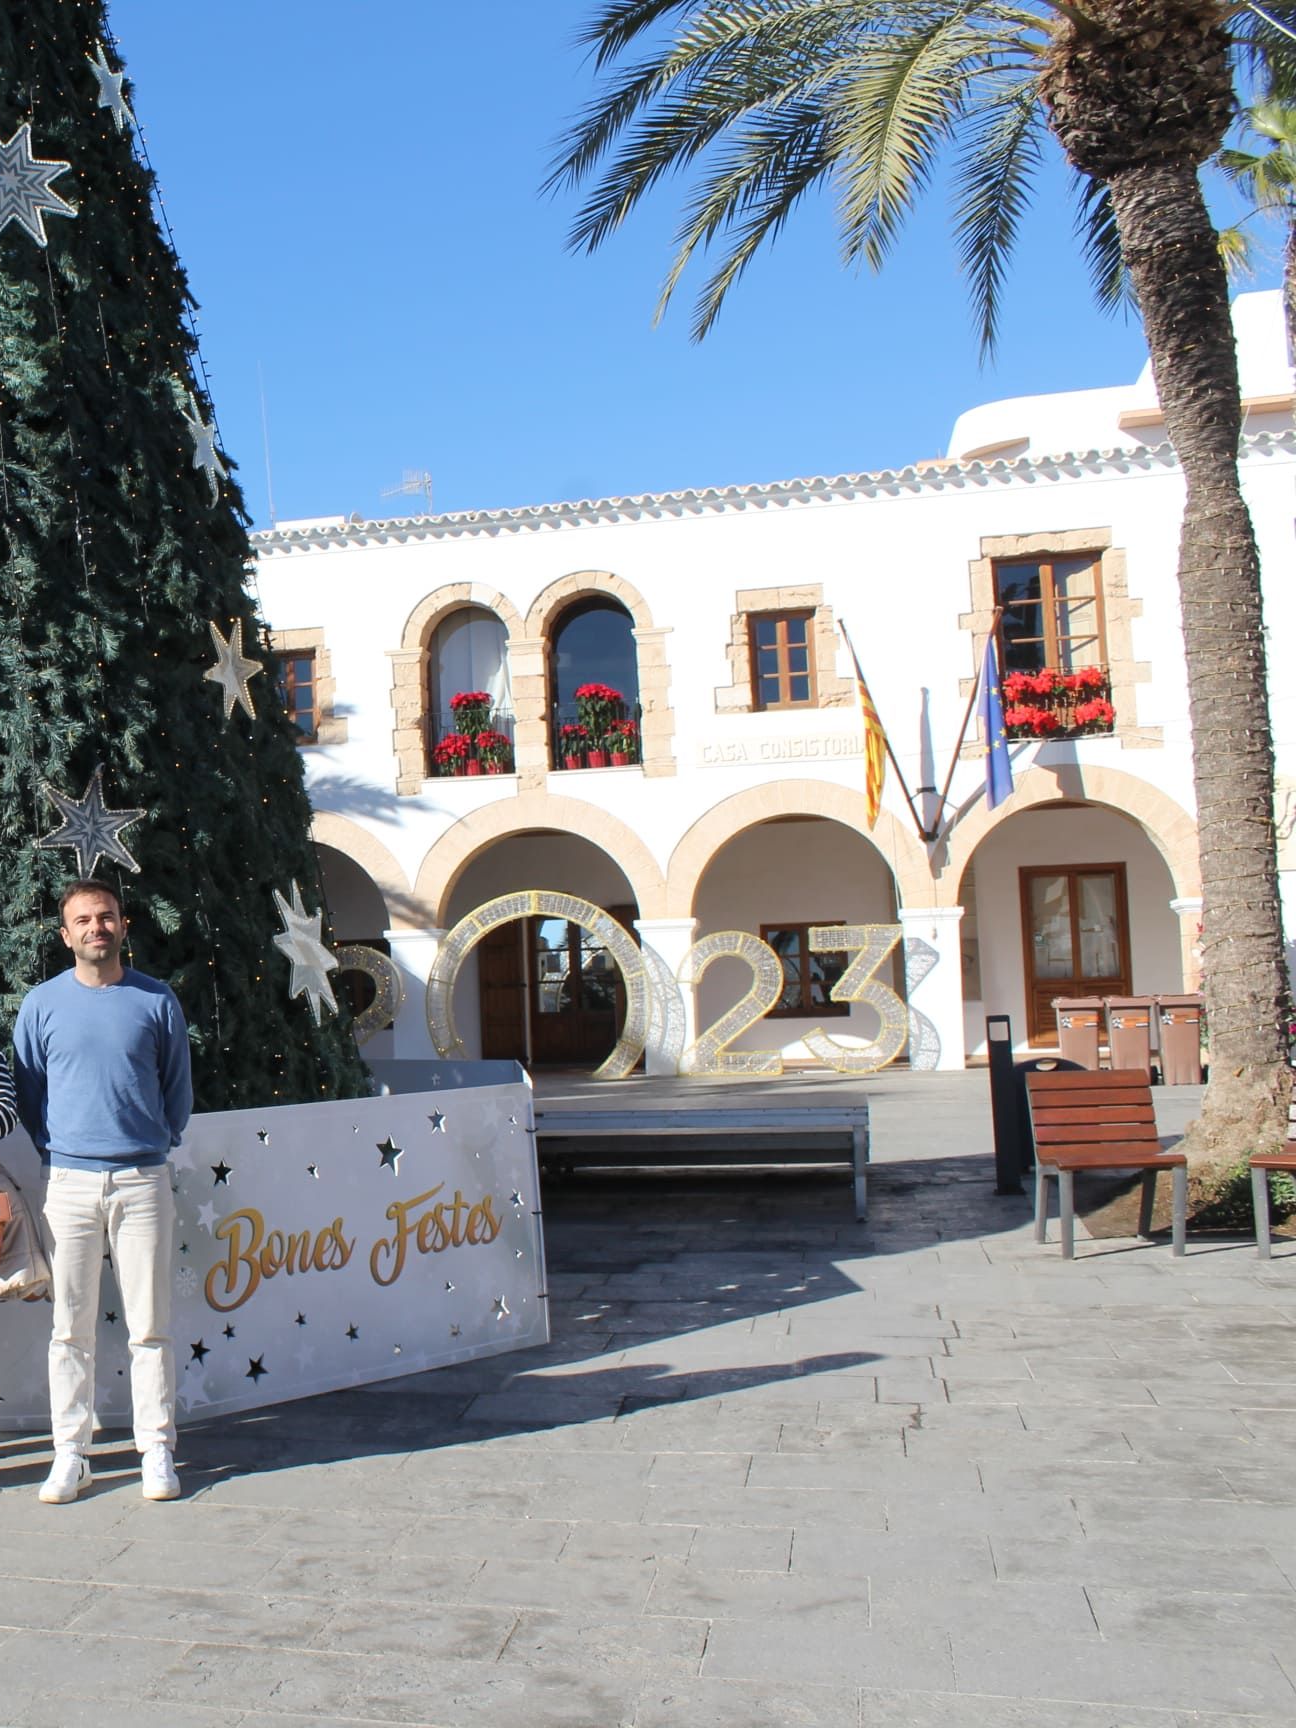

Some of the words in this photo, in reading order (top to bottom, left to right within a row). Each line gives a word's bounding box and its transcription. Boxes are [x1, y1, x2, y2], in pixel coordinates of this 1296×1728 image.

[704, 742, 749, 763] CASA
[204, 1208, 356, 1313] Bones
[369, 1181, 503, 1287] Festes
